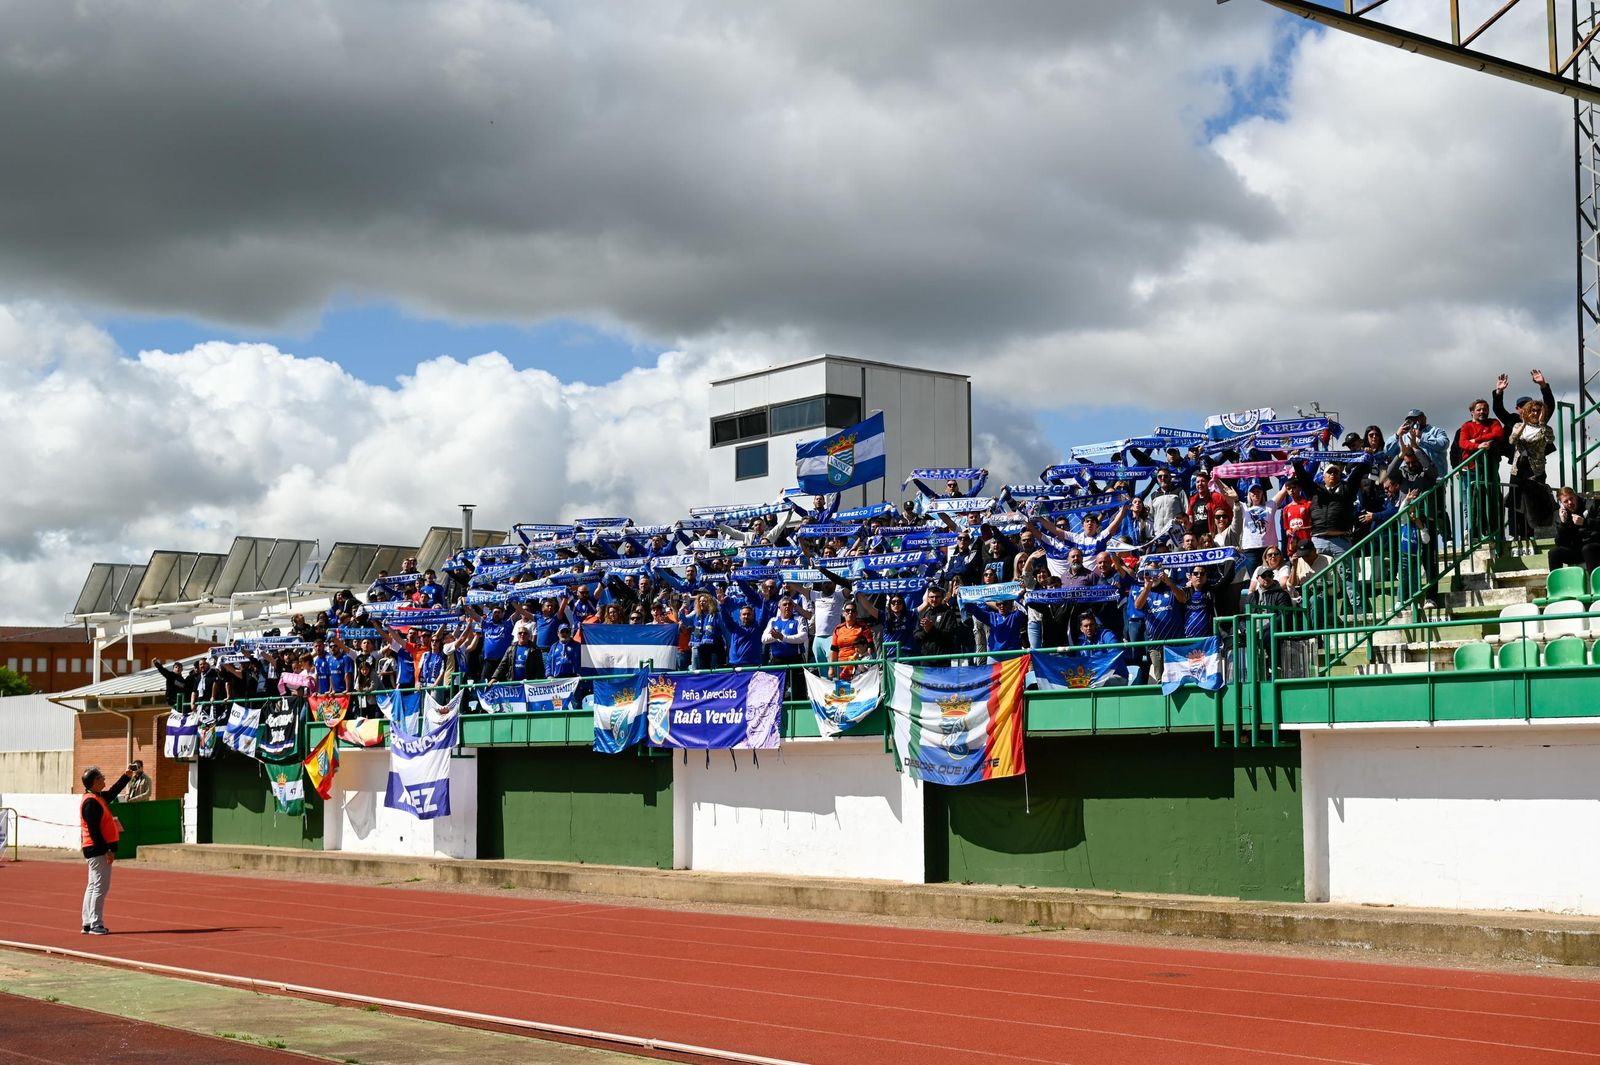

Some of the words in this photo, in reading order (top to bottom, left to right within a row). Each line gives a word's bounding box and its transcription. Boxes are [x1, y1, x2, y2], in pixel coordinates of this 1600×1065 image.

[1268, 423, 1301, 433] XEREZ
[1306, 421, 1321, 430] CD
[1293, 436, 1316, 444] XEREZ
[912, 469, 979, 480] XEREZ
[1010, 485, 1051, 493] XEREZ
[1052, 484, 1071, 493] CD
[947, 500, 991, 509] XEREZ
[1052, 498, 1093, 512] XEREZ
[1096, 494, 1112, 505] CD
[749, 549, 764, 558] CD
[765, 549, 800, 558] XEREZ
[869, 554, 906, 566] XEREZ
[907, 552, 922, 561] CD
[1160, 552, 1204, 564] XEREZ
[1206, 549, 1224, 559] CD
[535, 560, 566, 568] XEREZ
[862, 579, 906, 591] XEREZ
[1074, 588, 1117, 598] DEPORTIV
[469, 596, 494, 604] XEREZ
[344, 628, 372, 637] XEREZ
[528, 685, 554, 697] SHERRY
[682, 689, 700, 700] Peña
[702, 688, 737, 700] Xerecista
[673, 708, 702, 724] Rafa
[705, 707, 743, 724] Verdú
[905, 757, 936, 772] DESDE
[938, 765, 960, 775] QUE
